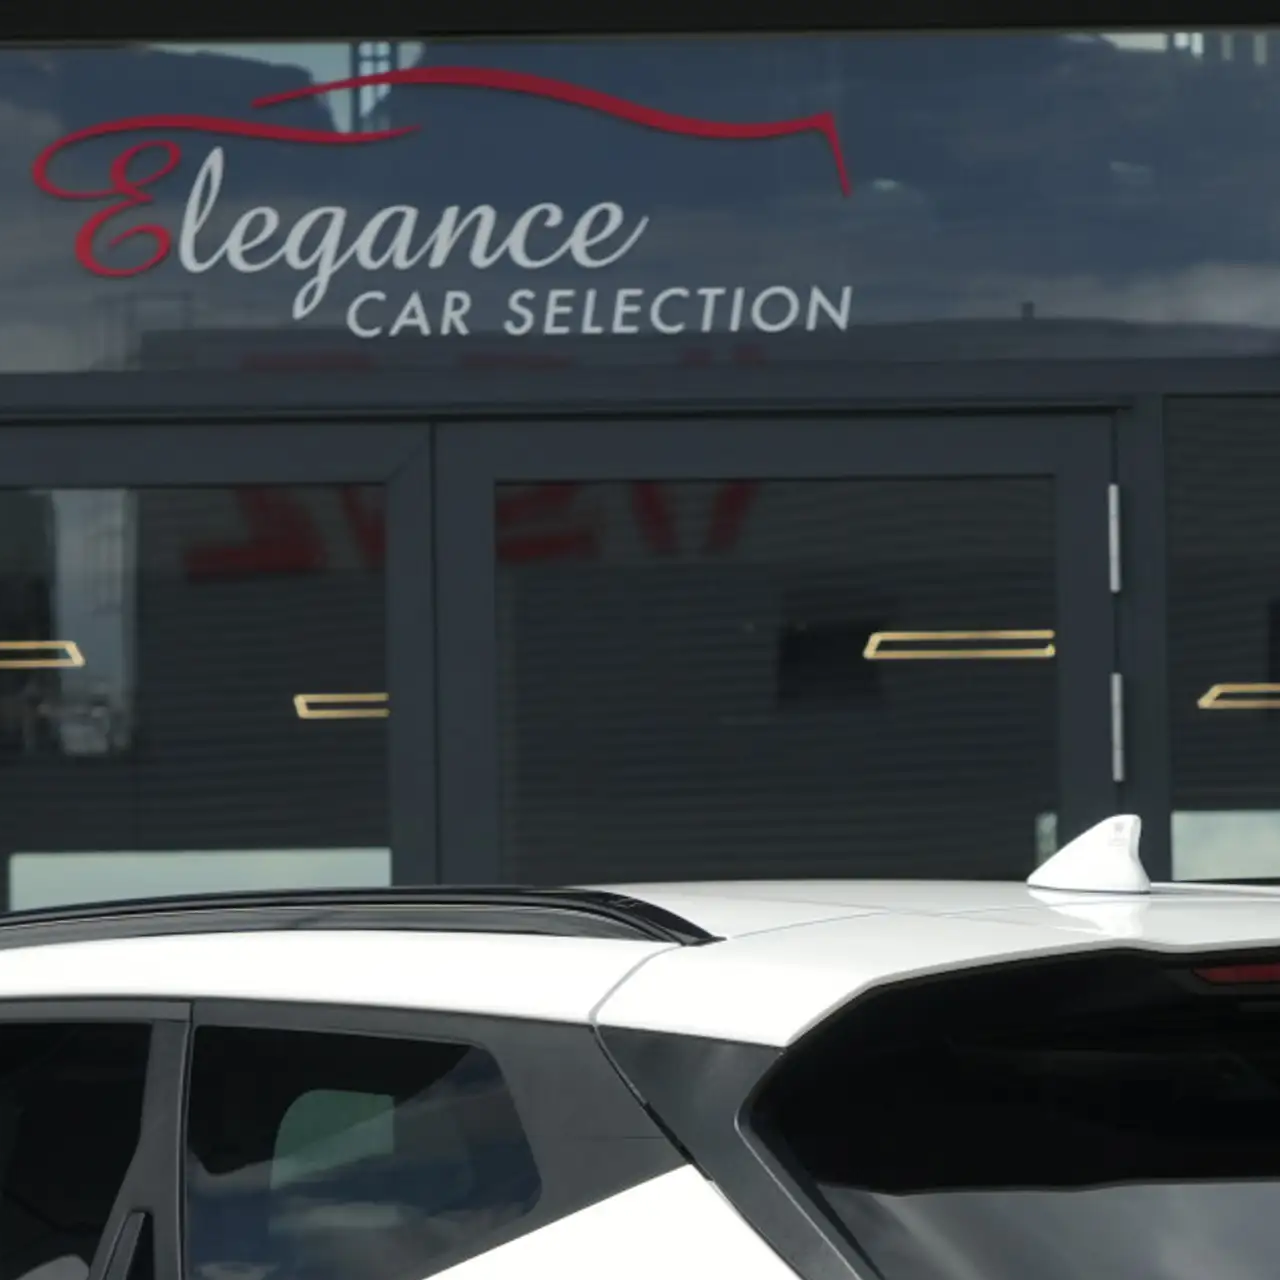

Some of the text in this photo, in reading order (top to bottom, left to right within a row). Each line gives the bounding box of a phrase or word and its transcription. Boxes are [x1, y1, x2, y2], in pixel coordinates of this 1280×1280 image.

[33, 115, 650, 321] Elegance
[346, 284, 854, 338] CAR SELECTION
